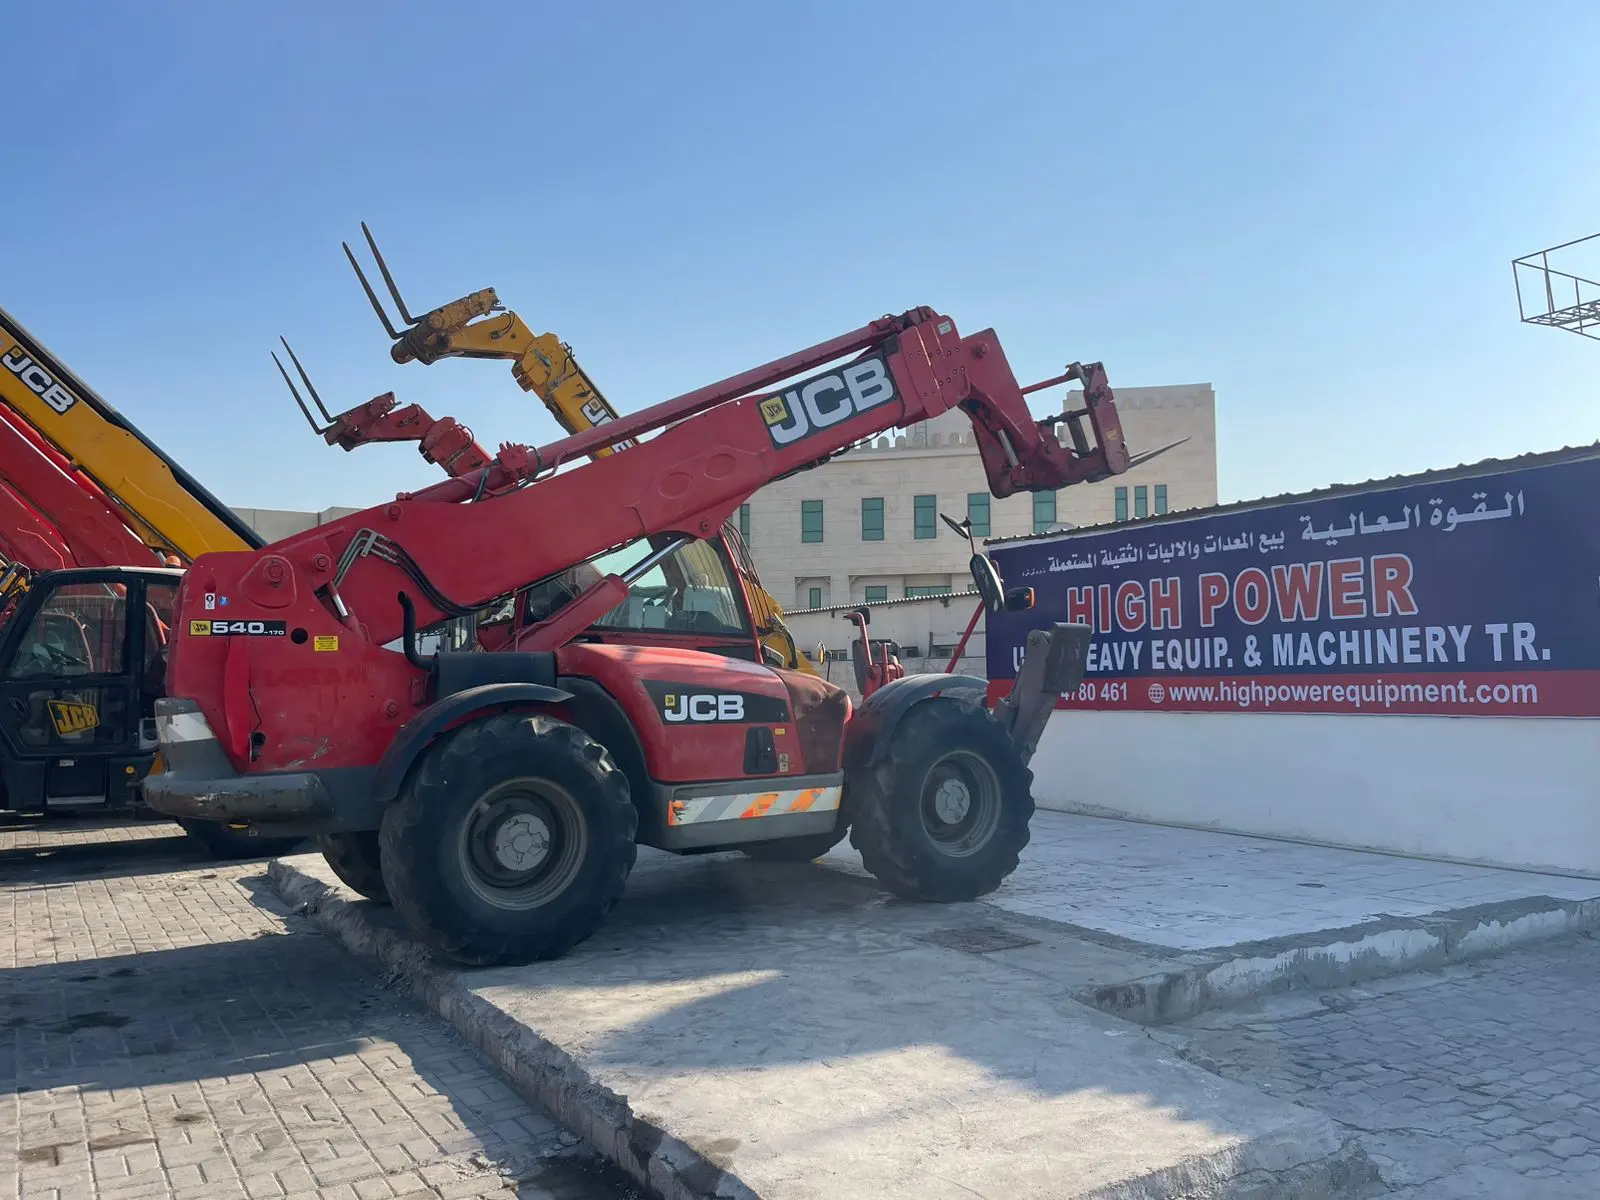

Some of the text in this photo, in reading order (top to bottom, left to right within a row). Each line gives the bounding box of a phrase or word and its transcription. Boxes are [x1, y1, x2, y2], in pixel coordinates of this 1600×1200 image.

[2, 353, 74, 412] JCB
[766, 403, 783, 418] JCB
[770, 358, 894, 445] JCB
[1299, 503, 1420, 546] العالية
[1429, 489, 1525, 532] القوة
[1204, 531, 1254, 552] المعدات
[1258, 530, 1285, 553] بيع
[1048, 552, 1097, 573] المستعملة
[1101, 543, 1143, 570] الثقيلة
[1066, 553, 1419, 634] HIGH POWER
[1086, 622, 1552, 673] EAVY EQUIP. & MACHINERY TR.
[665, 694, 745, 722] JCB
[1101, 682, 1128, 702] 461
[1169, 679, 1538, 708] www.highpowerequipment.com
[55, 704, 97, 734] JCB
